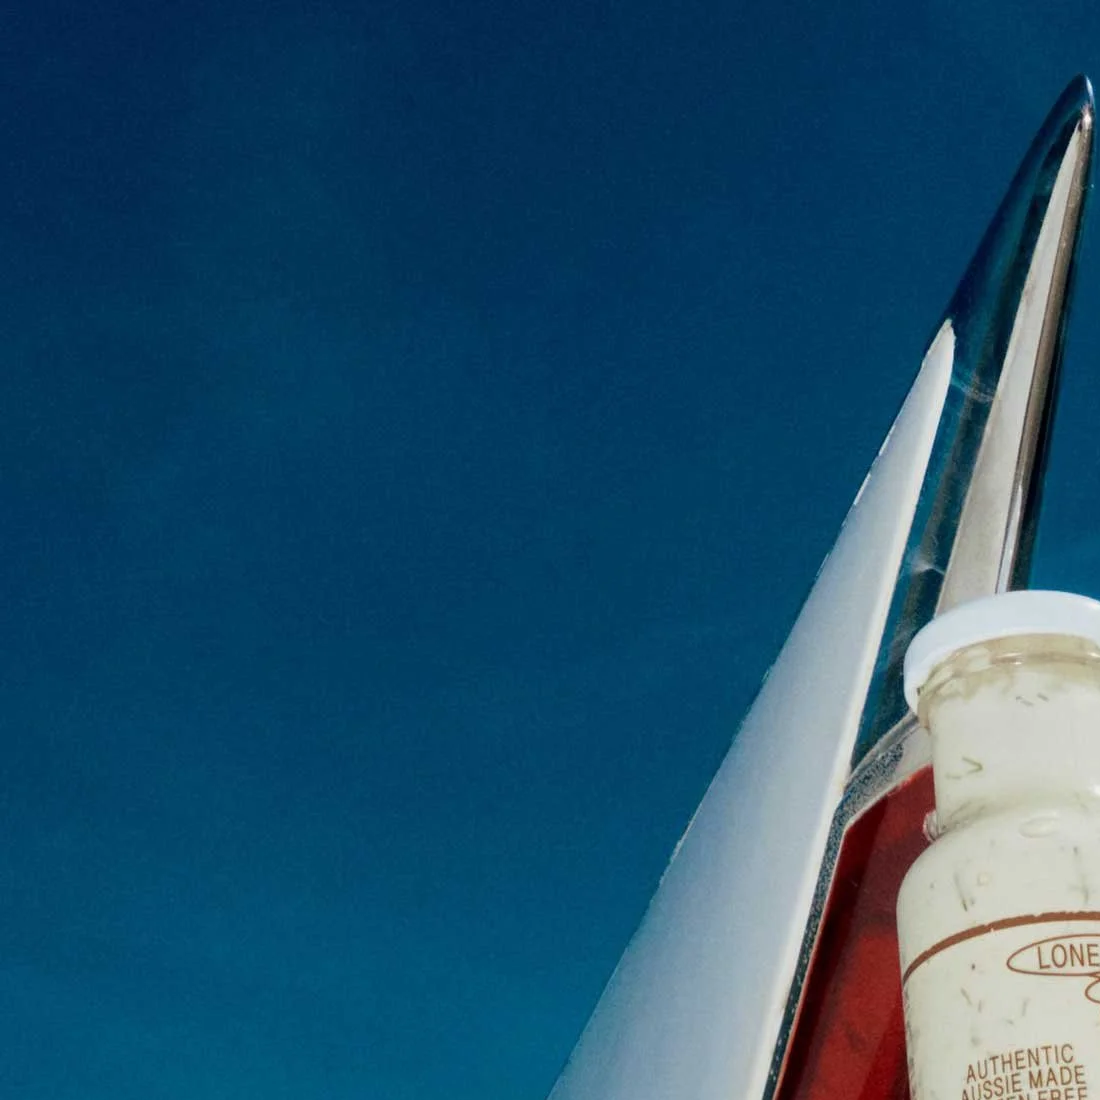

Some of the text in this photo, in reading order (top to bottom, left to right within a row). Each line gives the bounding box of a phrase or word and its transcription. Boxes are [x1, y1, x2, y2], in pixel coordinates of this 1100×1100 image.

[1037, 943, 1100, 969] LONE
[966, 1043, 1074, 1083] AUTHENTIC
[1028, 1065, 1086, 1089] MADE
